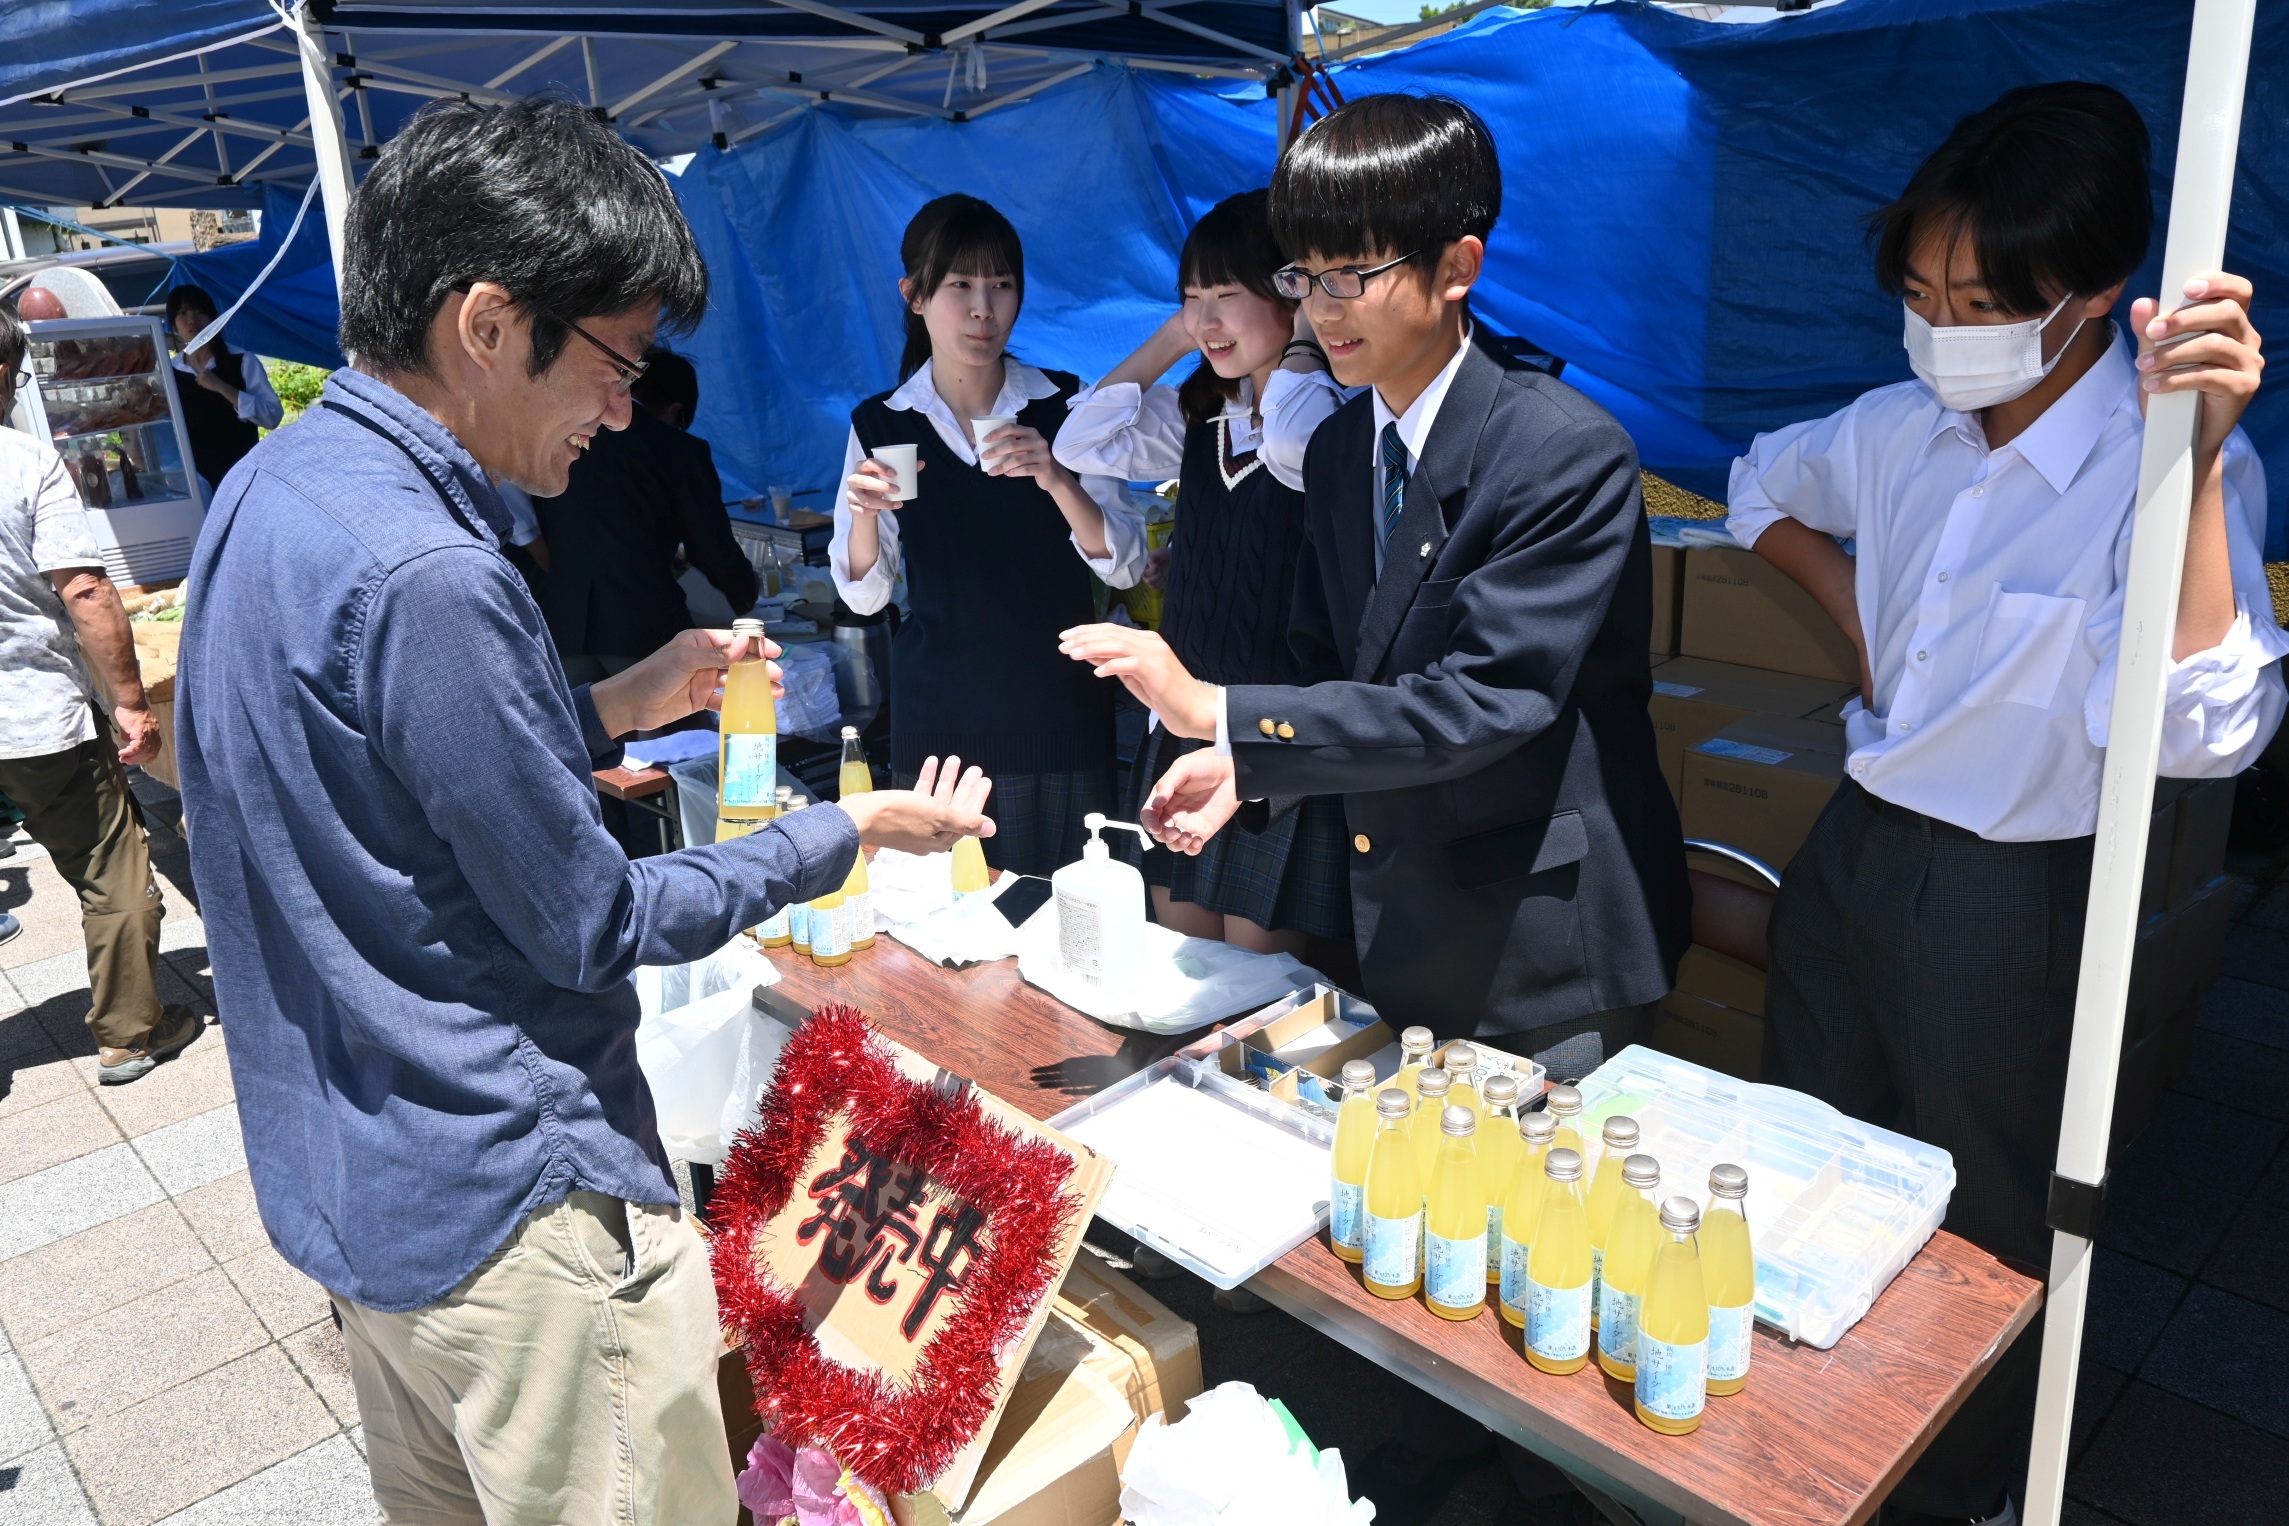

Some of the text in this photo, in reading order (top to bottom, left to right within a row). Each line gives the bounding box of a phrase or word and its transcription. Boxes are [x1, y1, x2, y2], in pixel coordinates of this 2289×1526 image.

[1341, 1189, 1352, 1236] 地サイダー
[1433, 1242, 1444, 1292] 地サイダー
[1510, 1248, 1521, 1298] 地サイダー
[1532, 1290, 1544, 1342] 地サイダー
[1612, 1296, 1624, 1350] 地サイダー
[1650, 1346, 1664, 1401] 地サイダー
